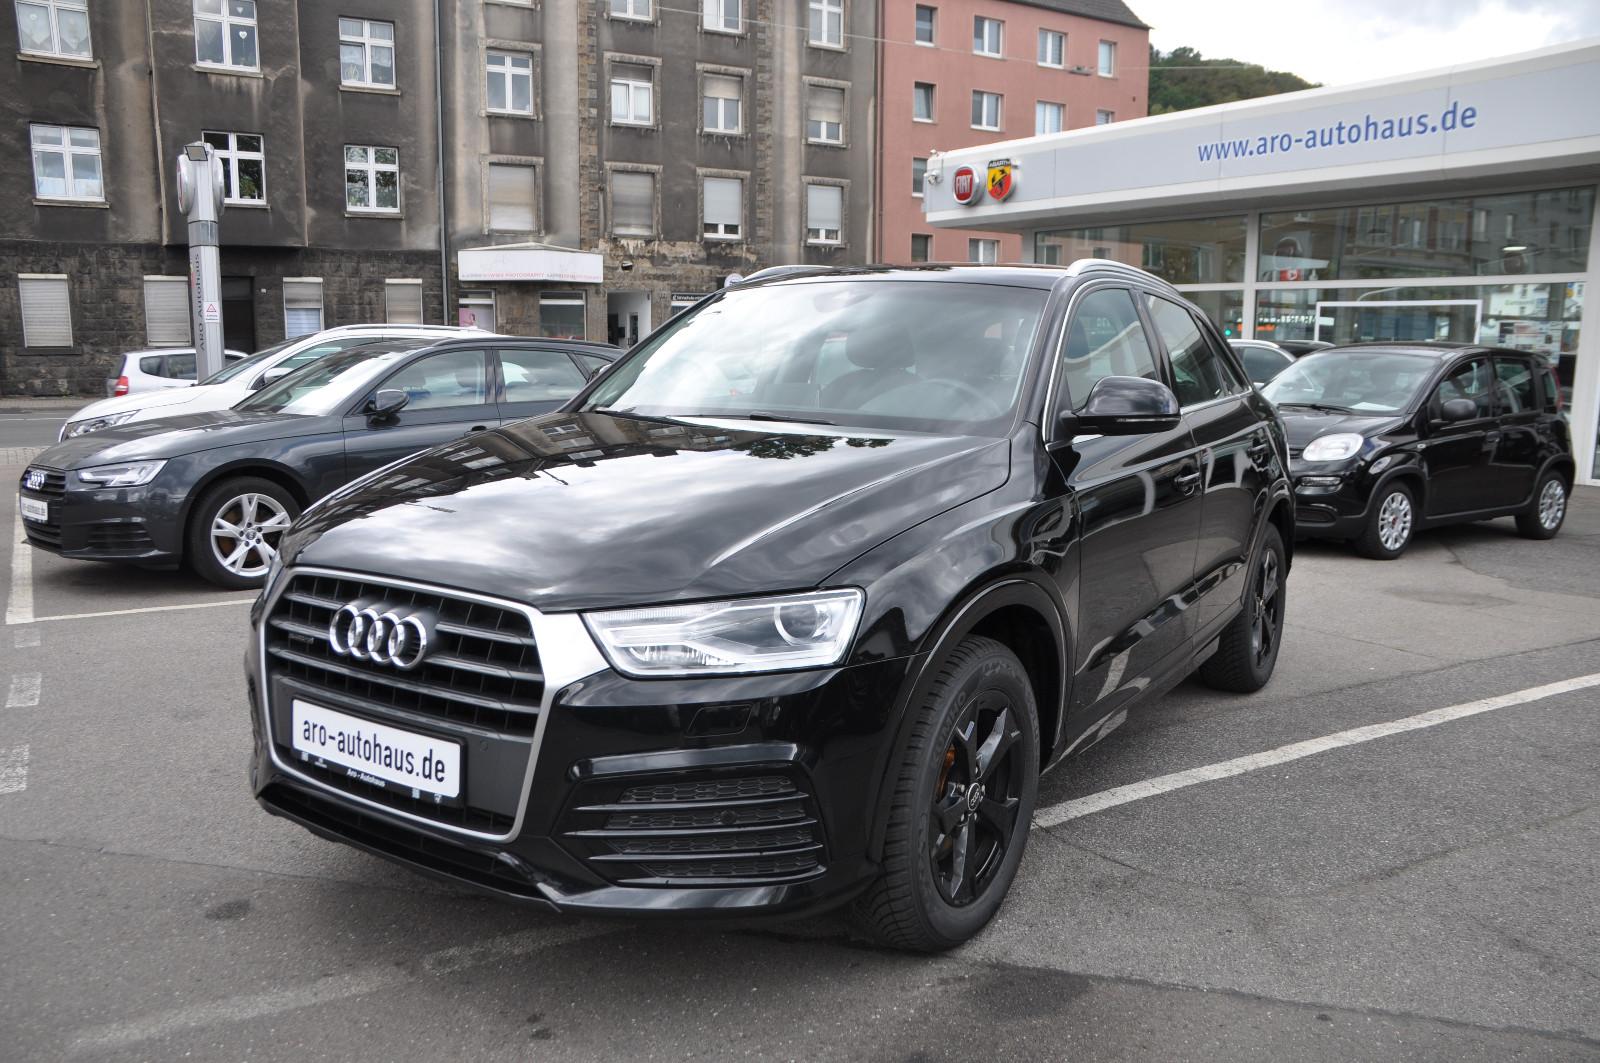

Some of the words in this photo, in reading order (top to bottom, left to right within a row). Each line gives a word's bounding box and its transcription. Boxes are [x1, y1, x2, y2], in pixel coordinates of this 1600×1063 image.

[1198, 100, 1477, 162] www.aro-autohaus.de
[955, 174, 972, 194] FIAT
[195, 254, 204, 318] Autohaus
[303, 719, 446, 783] aro-autohaus.de
